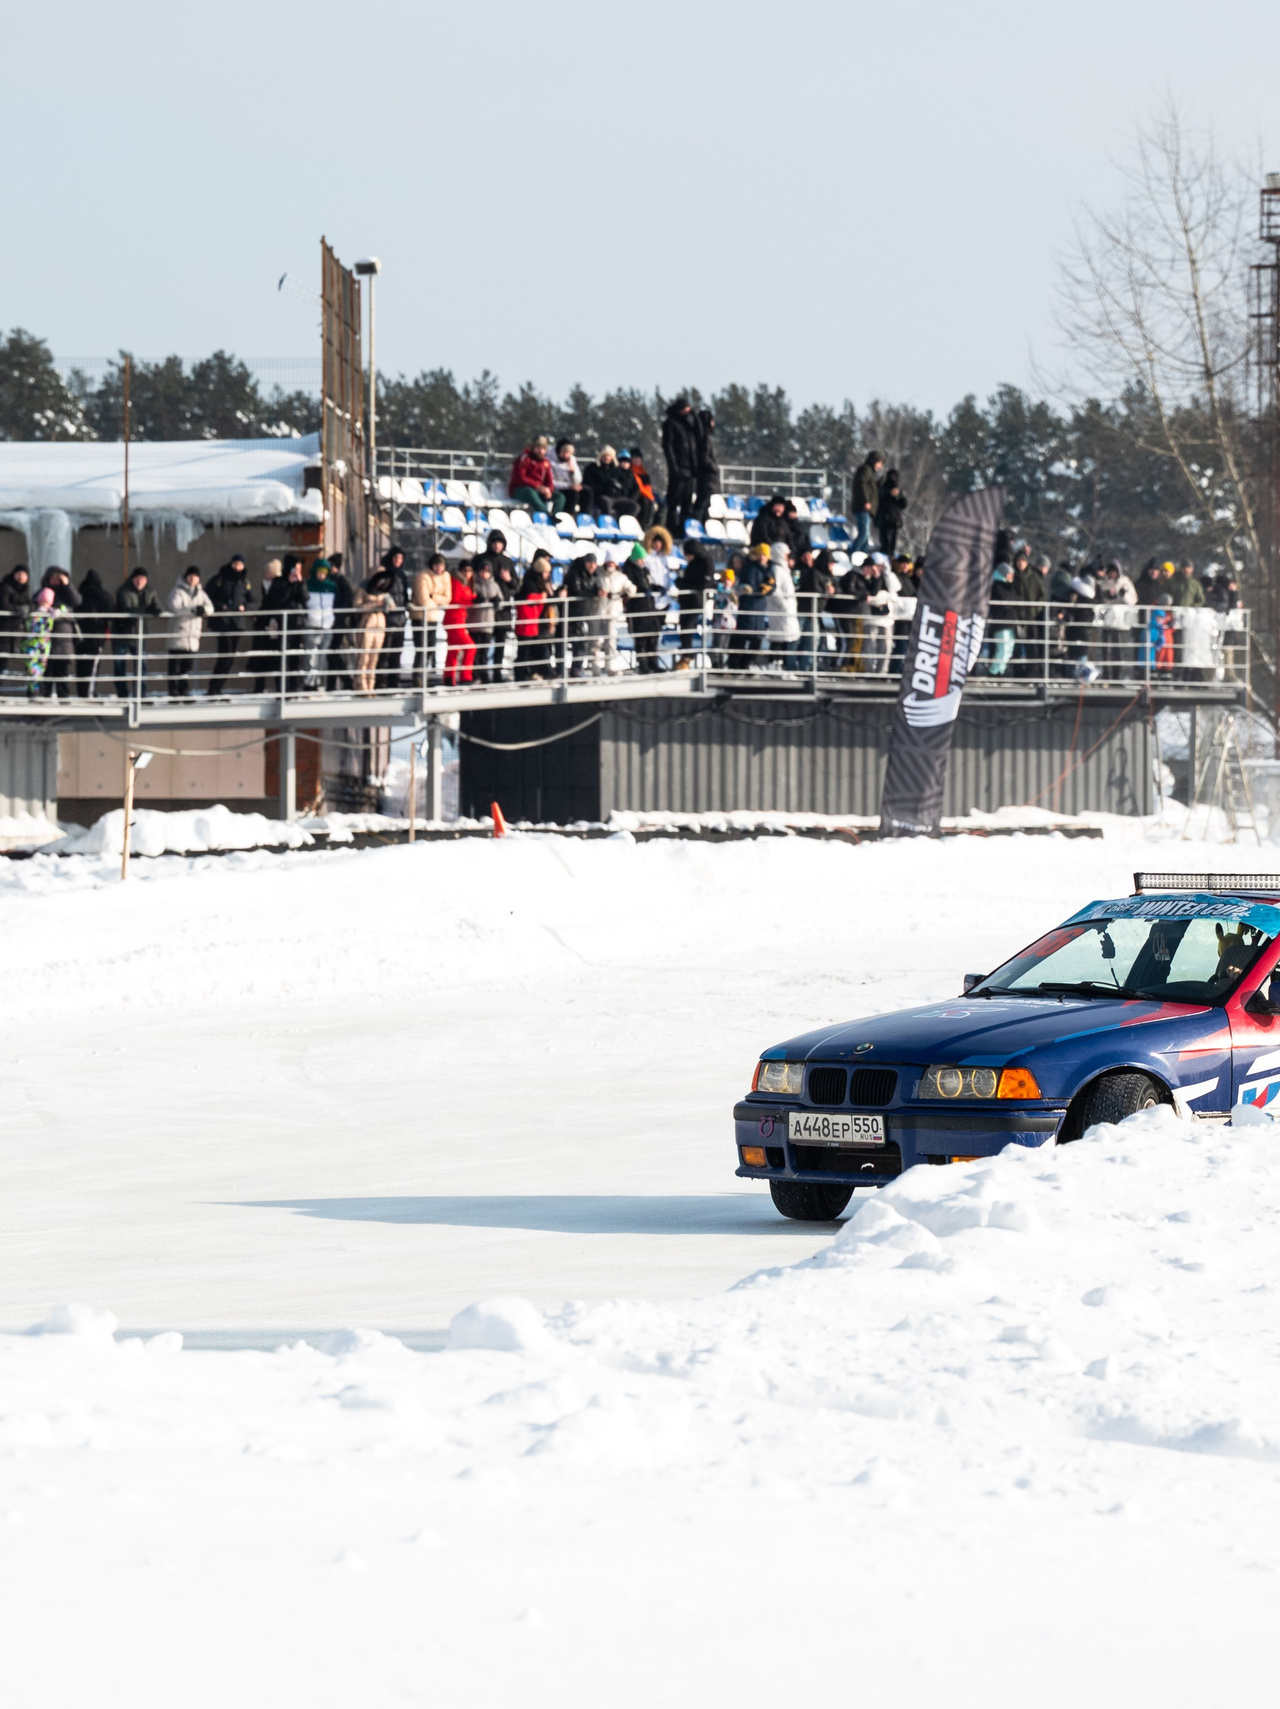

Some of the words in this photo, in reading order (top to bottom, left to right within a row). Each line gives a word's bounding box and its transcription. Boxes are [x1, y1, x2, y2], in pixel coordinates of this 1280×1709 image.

[911, 604, 945, 695] DRIFT
[950, 615, 973, 685] TRACK
[1132, 900, 1205, 917] WINTER
[1202, 903, 1249, 917] CUP
[853, 1117, 880, 1134] 550
[860, 1133, 874, 1141] RUS
